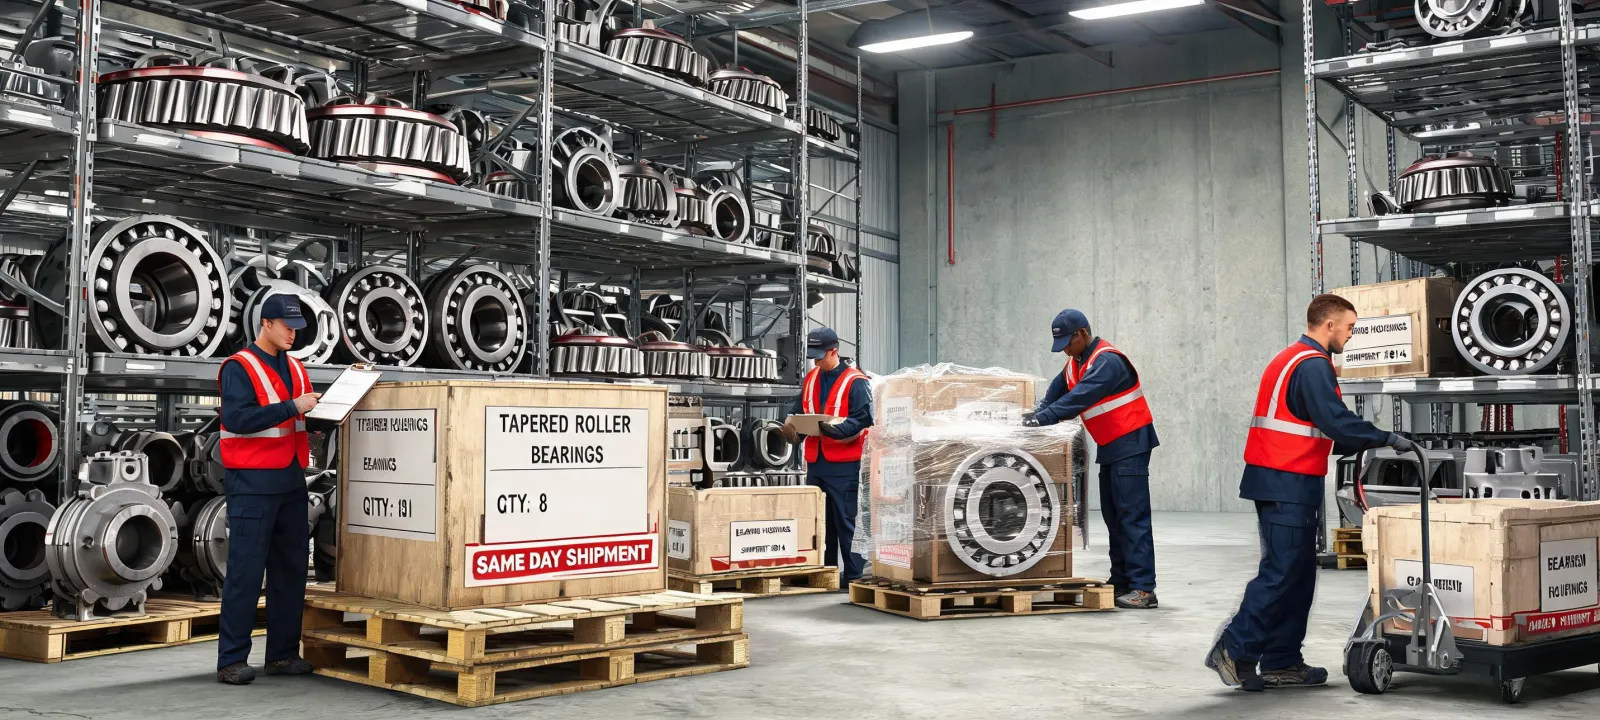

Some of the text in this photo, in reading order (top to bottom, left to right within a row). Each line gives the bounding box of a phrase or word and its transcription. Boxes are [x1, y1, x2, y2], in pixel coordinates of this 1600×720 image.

[500, 414, 631, 433] TAPERED ROLLER
[531, 445, 604, 464] BEARINGS
[539, 493, 548, 512] 8
[476, 553, 526, 574] SAME
[529, 550, 562, 569] DAY
[566, 544, 649, 566] SHIPMENT
